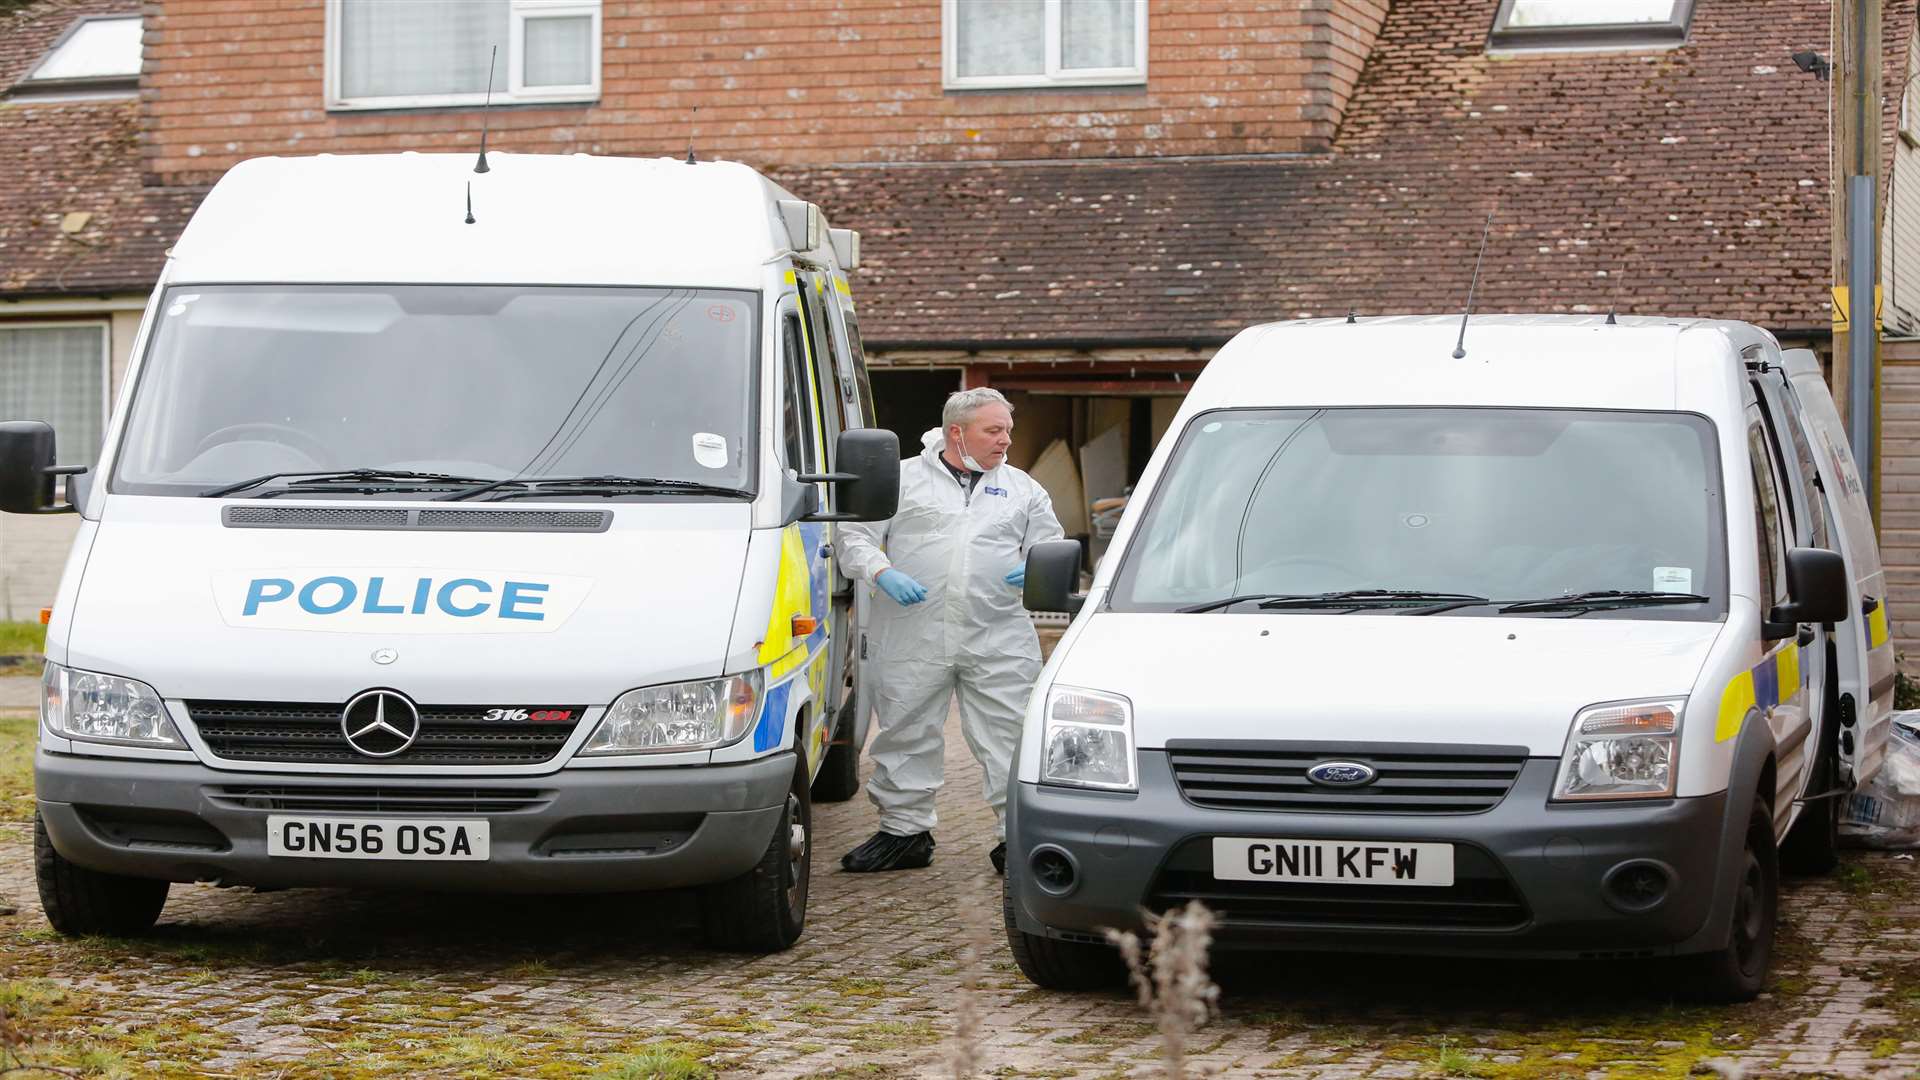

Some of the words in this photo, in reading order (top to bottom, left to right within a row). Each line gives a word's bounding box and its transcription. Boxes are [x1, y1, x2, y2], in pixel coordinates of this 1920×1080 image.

[242, 576, 549, 621] POLICE
[1324, 767, 1359, 781] Ford
[283, 822, 383, 854] GN56
[397, 825, 472, 855] OSA
[1248, 843, 1323, 877] GN11
[1337, 846, 1418, 880] KFW
